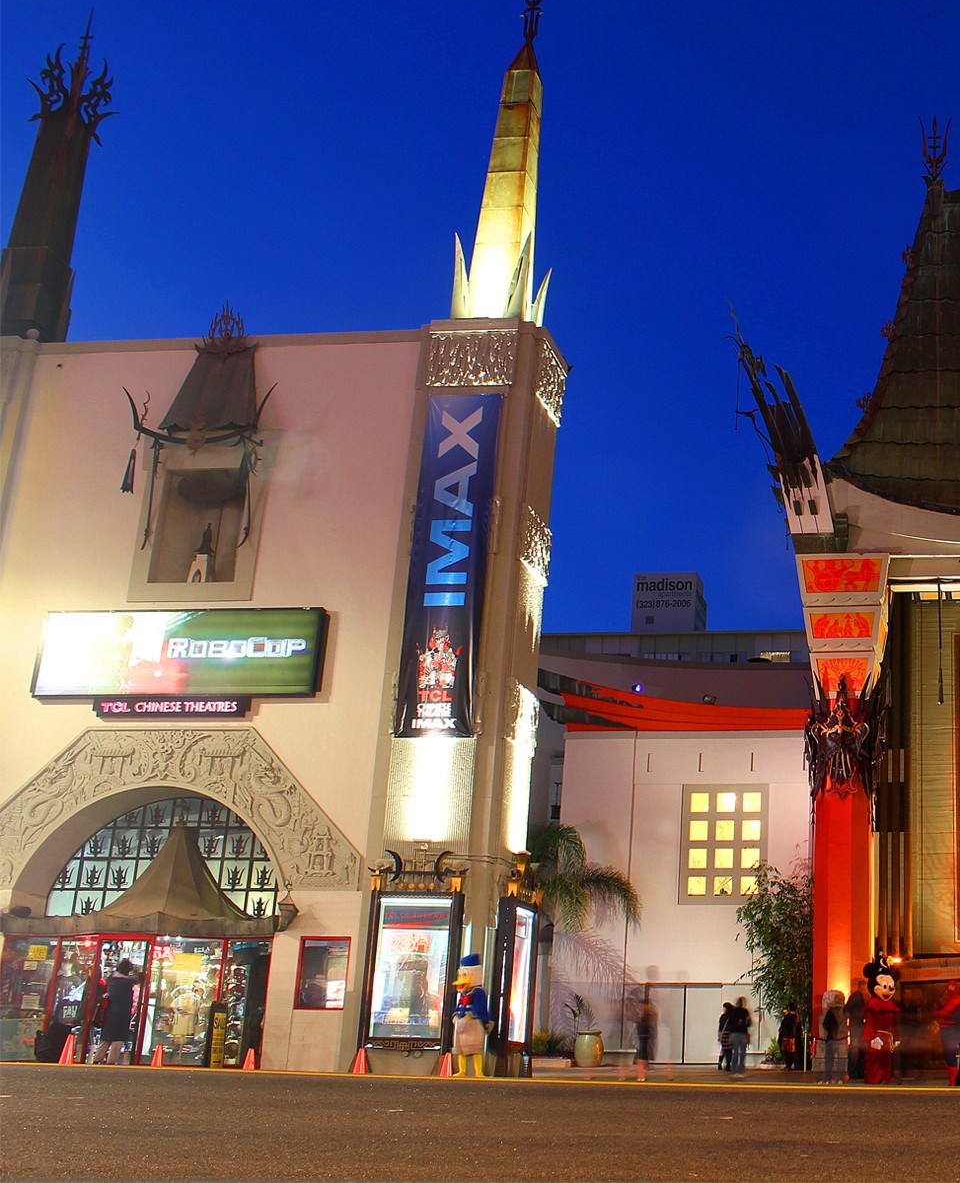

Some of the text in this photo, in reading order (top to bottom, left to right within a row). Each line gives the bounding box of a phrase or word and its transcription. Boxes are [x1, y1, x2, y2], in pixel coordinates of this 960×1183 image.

[423, 406, 483, 606] IMAX
[636, 578, 693, 592] madison
[636, 599, 692, 609] (323) 876-2006
[417, 689, 453, 702] TCL
[100, 701, 238, 713] TCL CHINESE THEATRES
[411, 718, 457, 729] IMAX
